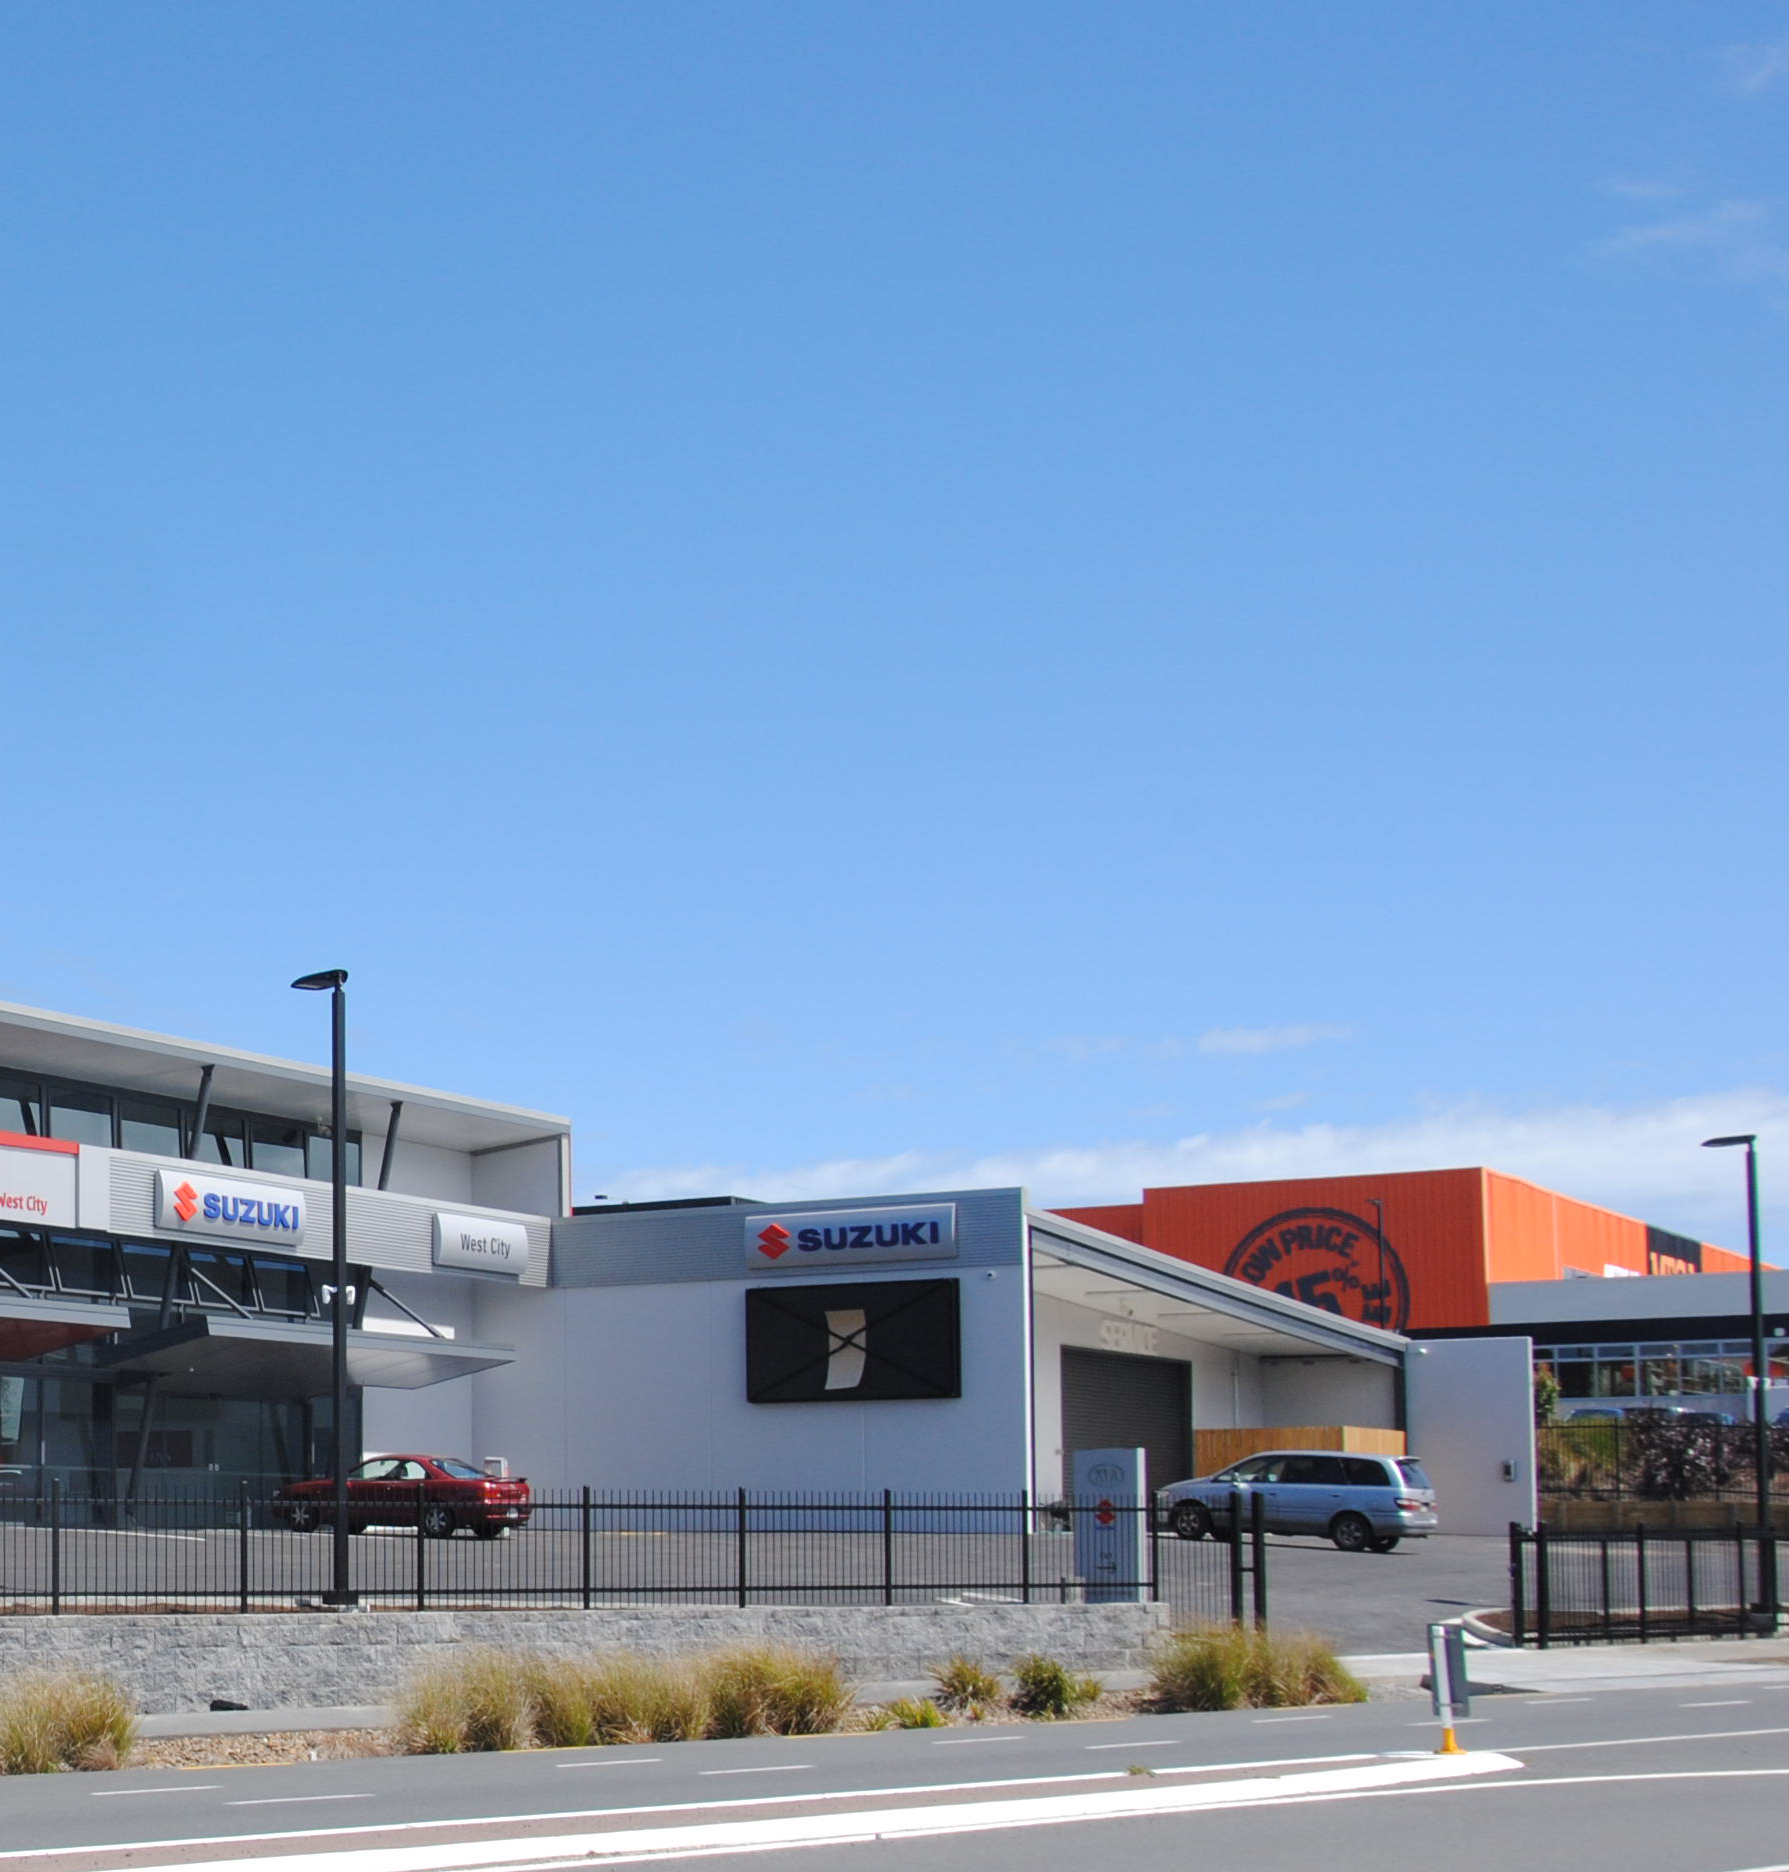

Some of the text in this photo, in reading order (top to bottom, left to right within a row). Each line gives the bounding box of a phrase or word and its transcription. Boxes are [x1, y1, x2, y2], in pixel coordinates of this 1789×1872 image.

[26, 1194, 48, 1216] City
[203, 1192, 300, 1231] SUZUKI
[460, 1232, 512, 1260] West City
[797, 1220, 940, 1252] SUZUKI
[1241, 1237, 1283, 1284] OW
